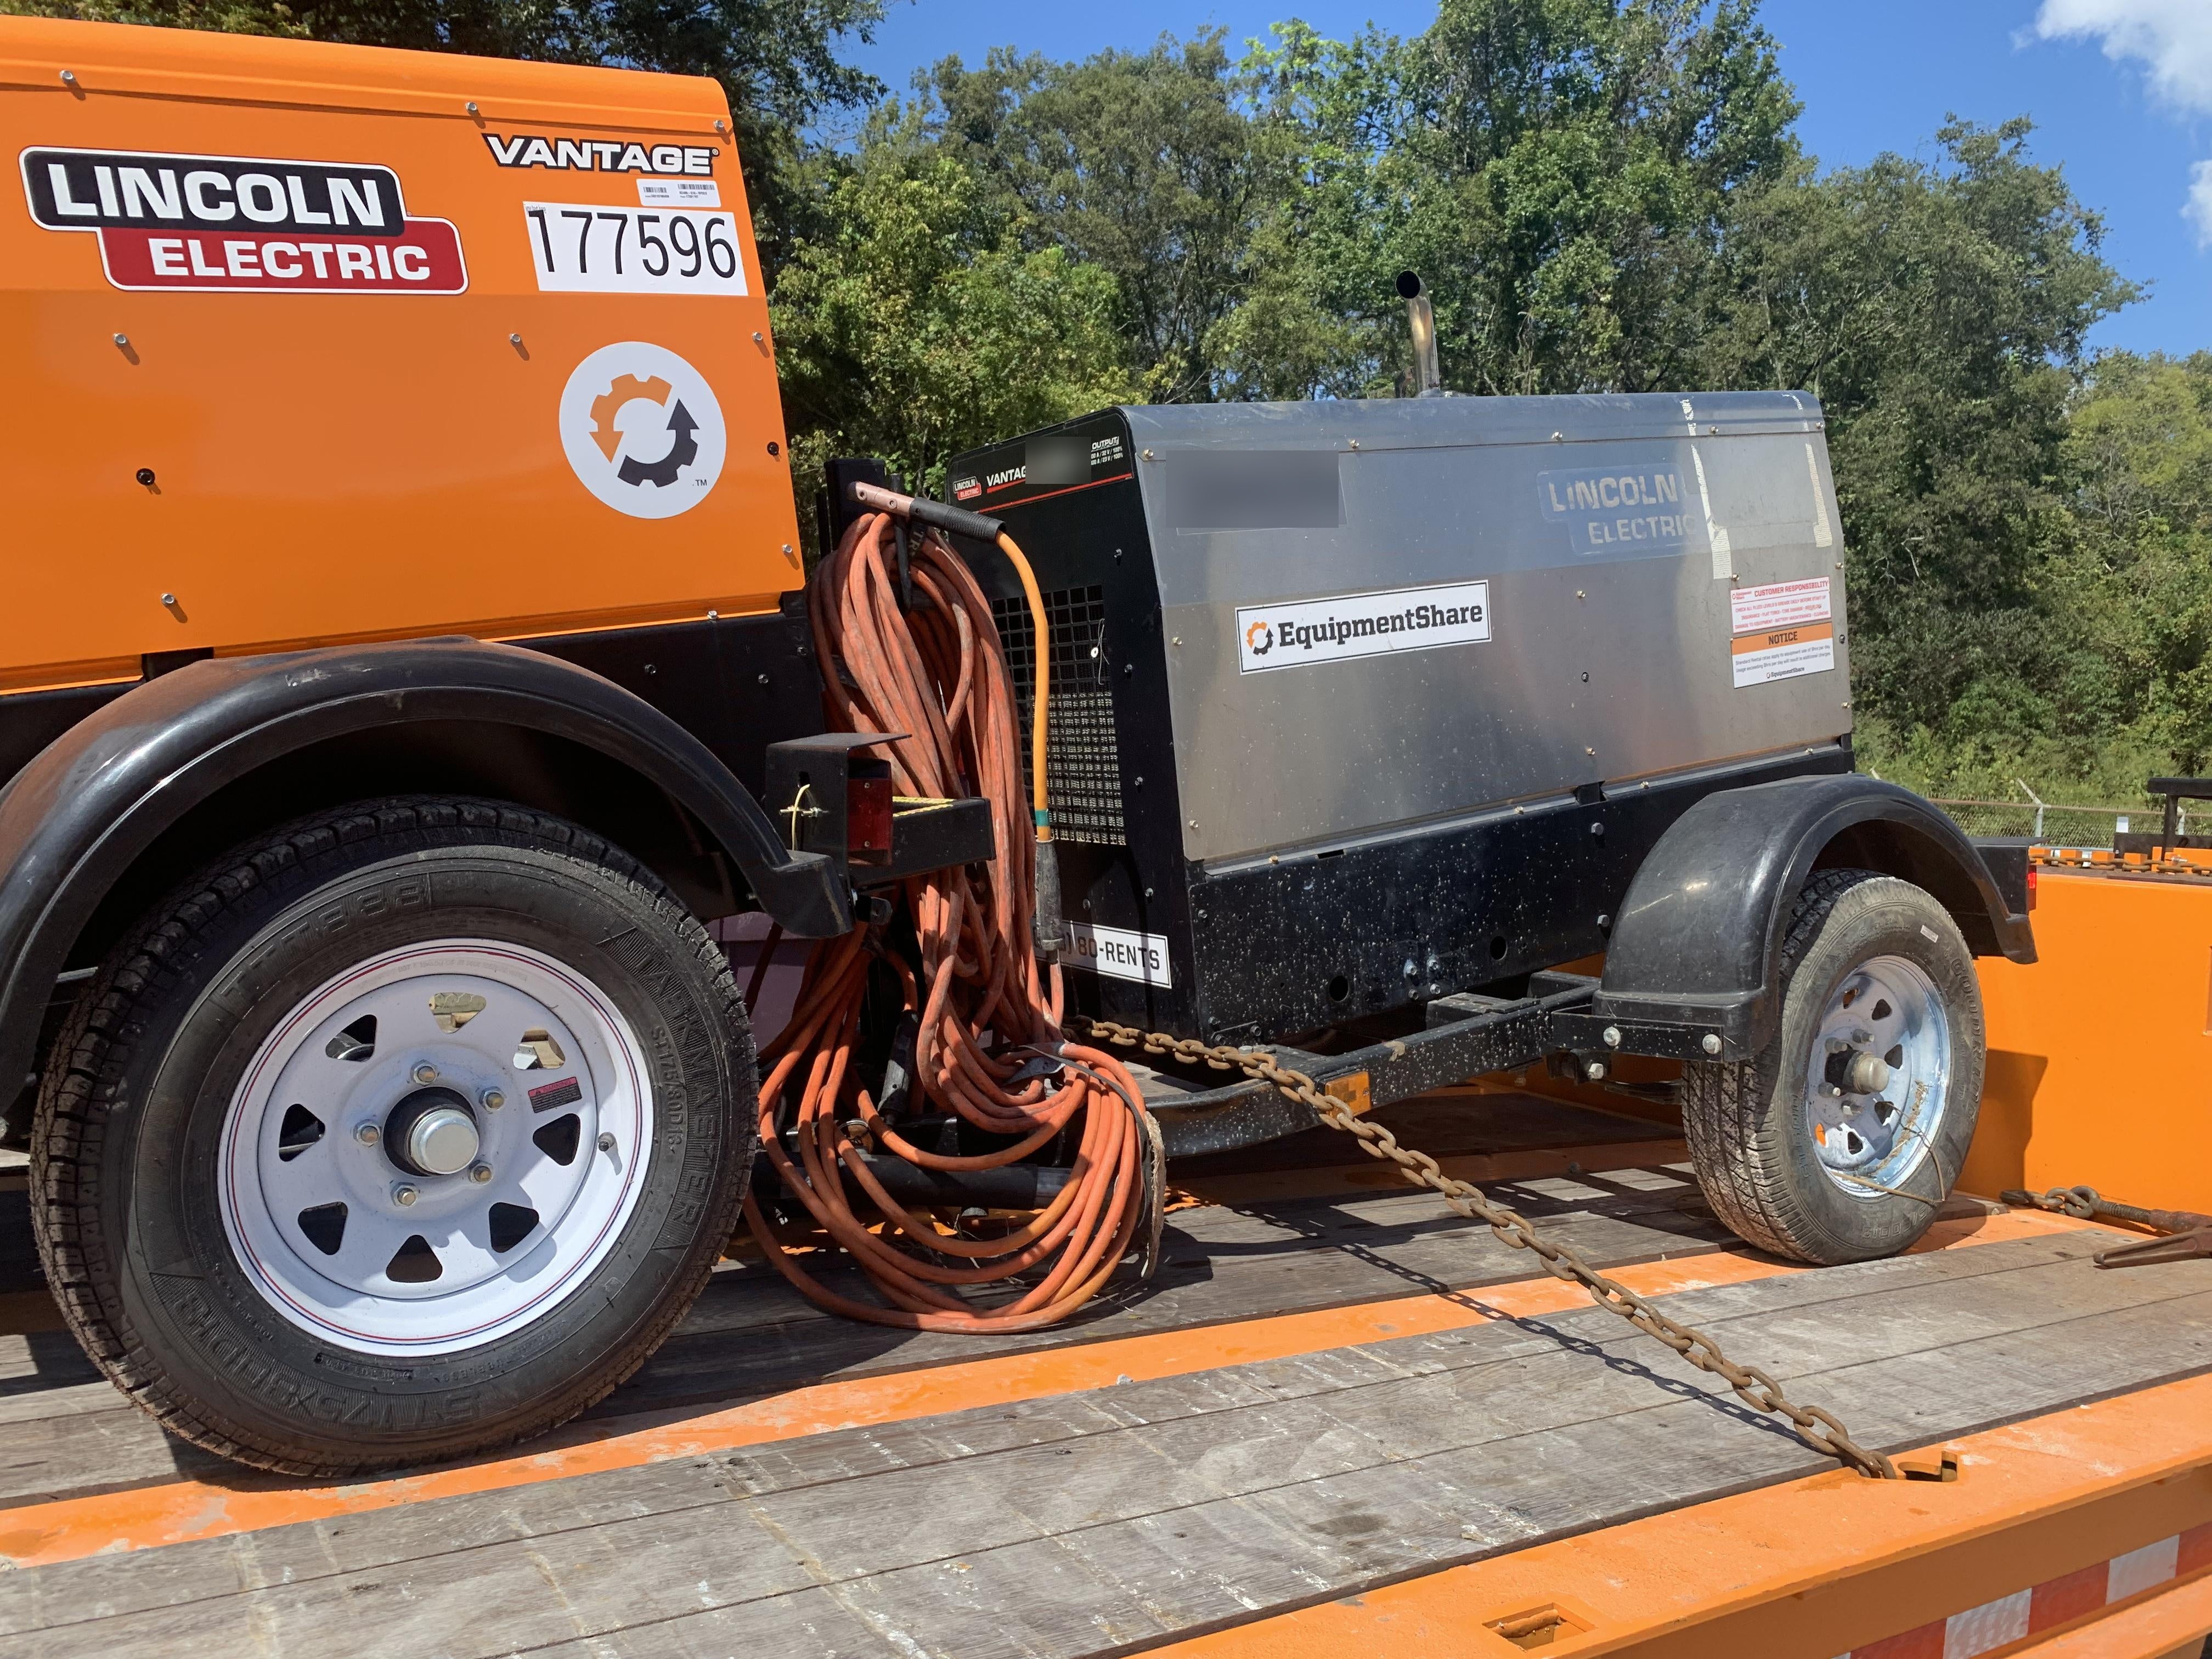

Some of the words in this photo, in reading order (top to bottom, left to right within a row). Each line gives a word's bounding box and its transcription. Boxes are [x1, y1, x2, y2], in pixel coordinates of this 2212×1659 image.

[483, 134, 712, 176] VANTAGE
[47, 163, 385, 226] LINCOLN
[528, 209, 736, 278] 177596
[148, 238, 431, 280] ELECTRIC
[1092, 436, 1118, 450] OUTPUT
[955, 478, 976, 491] LINCOLN
[986, 465, 1025, 487] VANTAG
[960, 488, 979, 498] ELECTRIC
[1548, 474, 1678, 511] LINCOLN
[1588, 514, 1697, 544] ELECTRIC
[1754, 586, 1784, 597] CUSTOMER
[1785, 580, 1829, 592] RESPONSIBILITY
[1278, 605, 1482, 650] EquipmentShare
[1768, 631, 1798, 645] NOTICE
[1771, 667, 1804, 678] EquipmentShare
[1077, 936, 1160, 970] 80-RENTS
